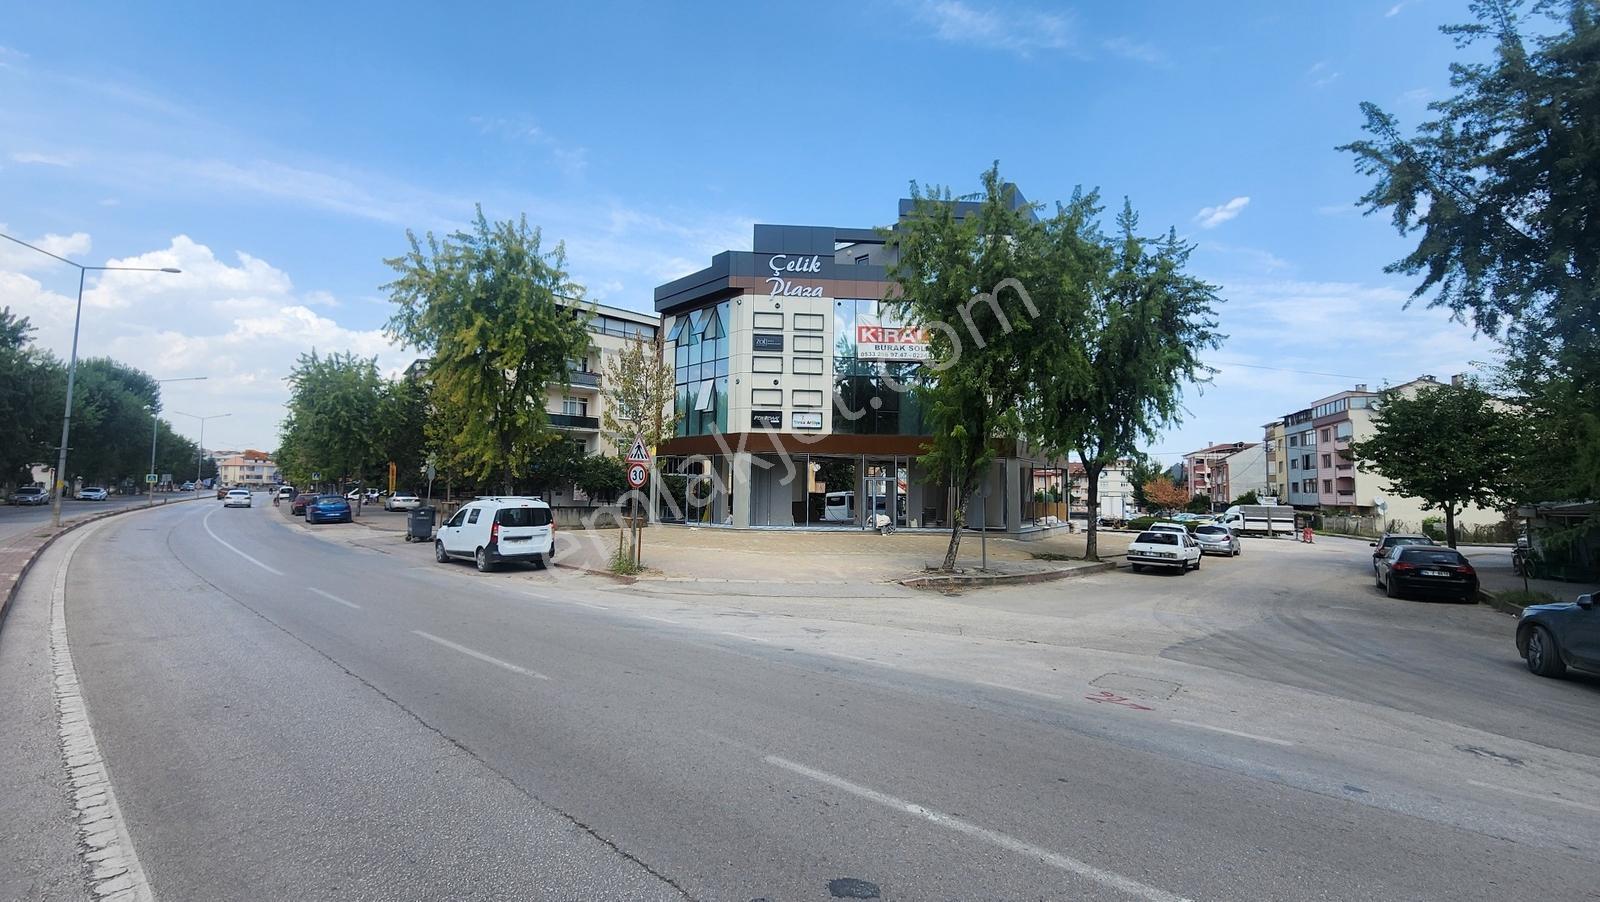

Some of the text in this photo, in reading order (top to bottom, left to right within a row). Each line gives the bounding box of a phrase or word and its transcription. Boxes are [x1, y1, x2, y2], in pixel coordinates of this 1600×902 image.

[768, 254, 821, 276] Çelik
[765, 277, 824, 299] Plaza
[632, 469, 644, 481] 30
